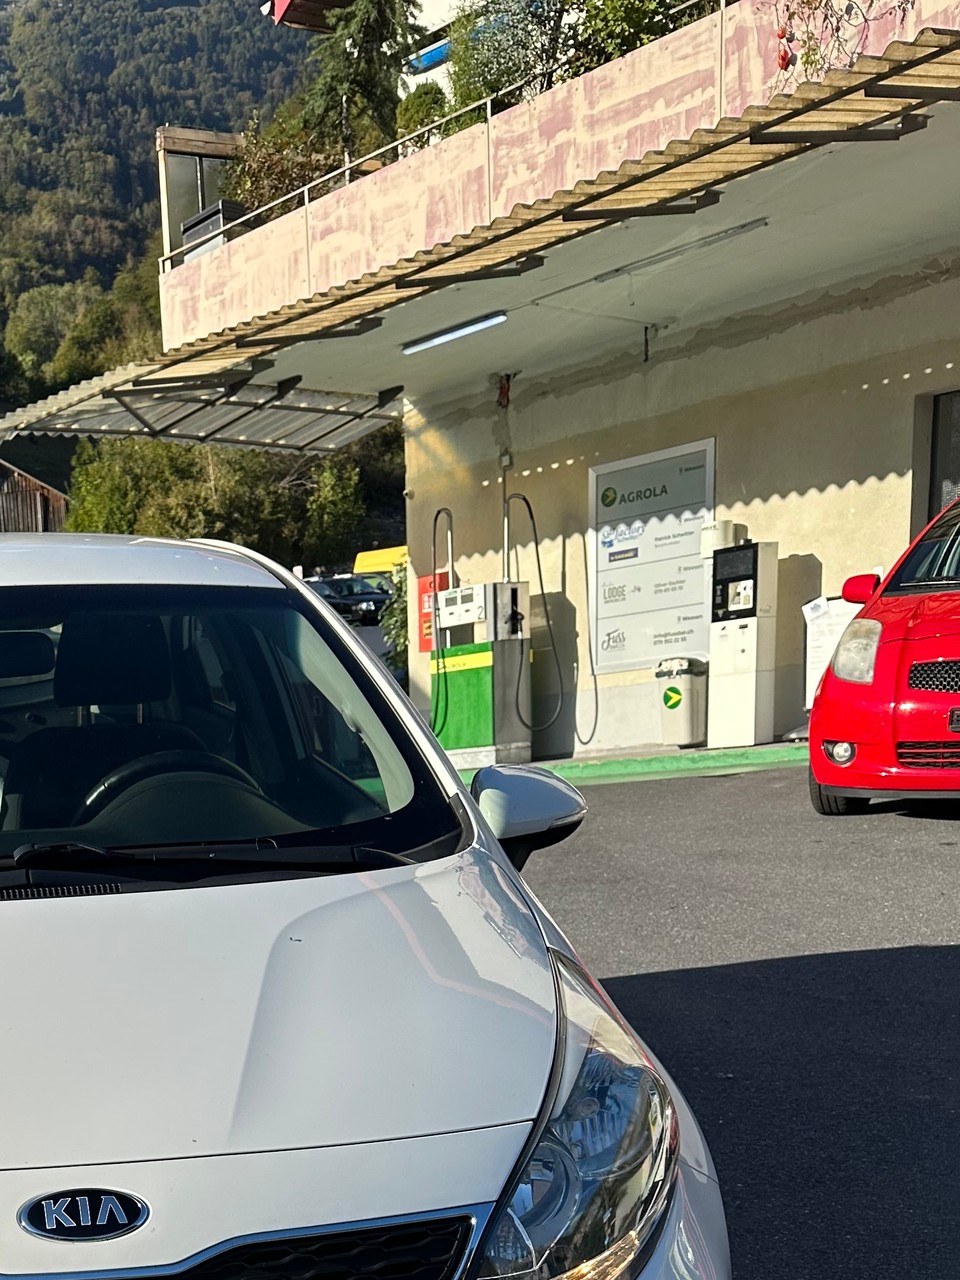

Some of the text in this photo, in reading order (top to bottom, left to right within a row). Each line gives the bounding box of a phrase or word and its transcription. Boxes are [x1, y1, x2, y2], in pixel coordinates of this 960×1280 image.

[619, 484, 668, 505] AGROLA
[603, 584, 627, 600] LODGE
[477, 605, 484, 620] 2
[41, 1195, 129, 1230] KIA
